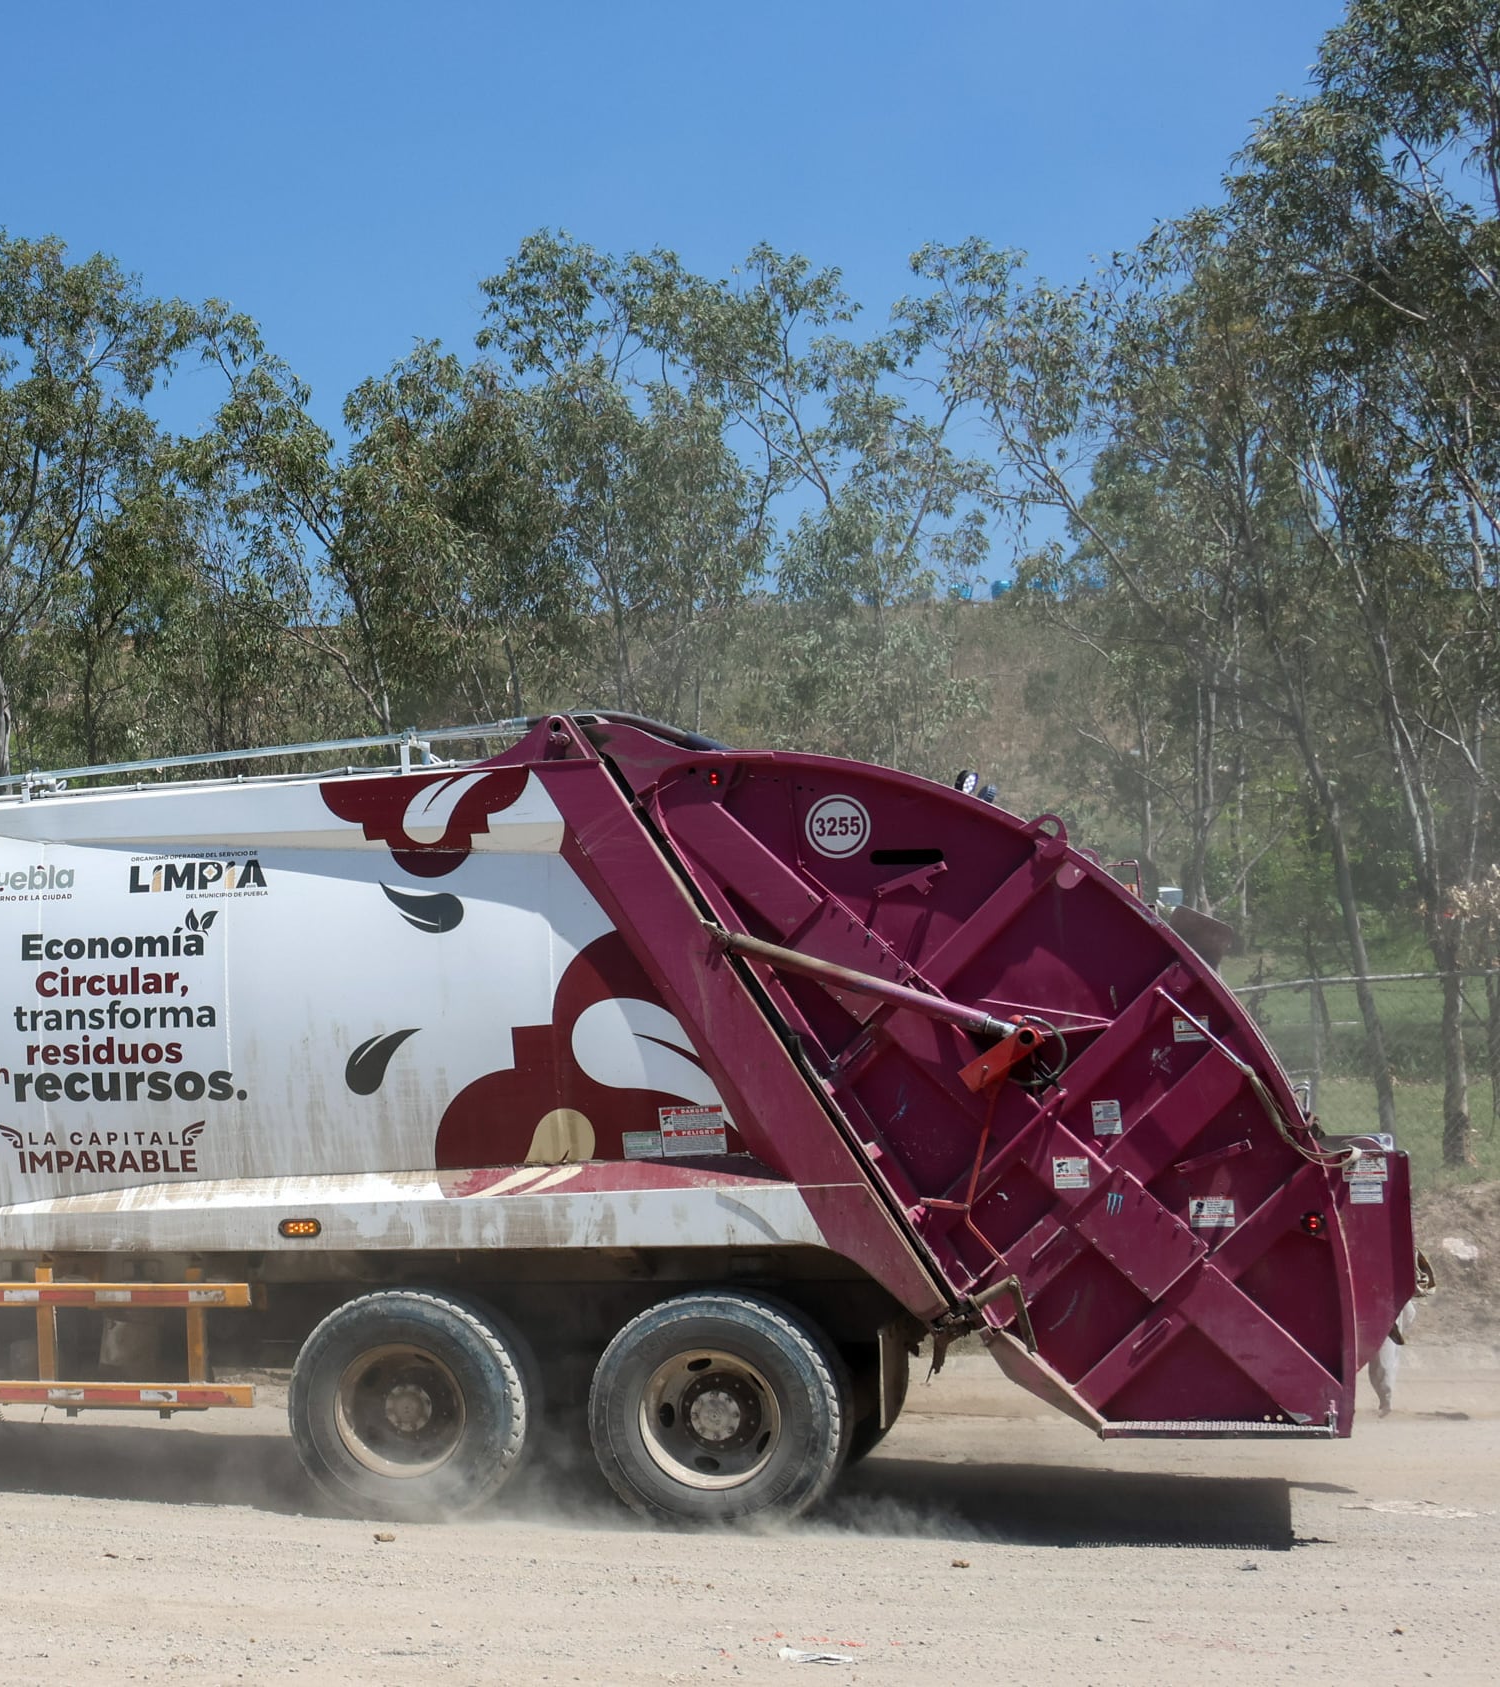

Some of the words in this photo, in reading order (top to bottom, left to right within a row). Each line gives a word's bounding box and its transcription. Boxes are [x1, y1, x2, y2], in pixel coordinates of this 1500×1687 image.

[815, 816, 861, 837] 3255
[130, 854, 169, 862] ORGANISMO
[169, 852, 204, 860] OPERADOR
[218, 850, 249, 858] SERVICIO
[42, 893, 73, 901] CIUDAD
[21, 926, 205, 961] Economía
[35, 966, 189, 998] Circular,
[13, 1000, 216, 1032] transforma
[26, 1034, 183, 1066] residuos
[13, 1070, 248, 1102] recursos.
[28, 1131, 57, 1146] LA
[69, 1131, 179, 1146] CAPITAL
[18, 1149, 198, 1174] IMPARABLE
